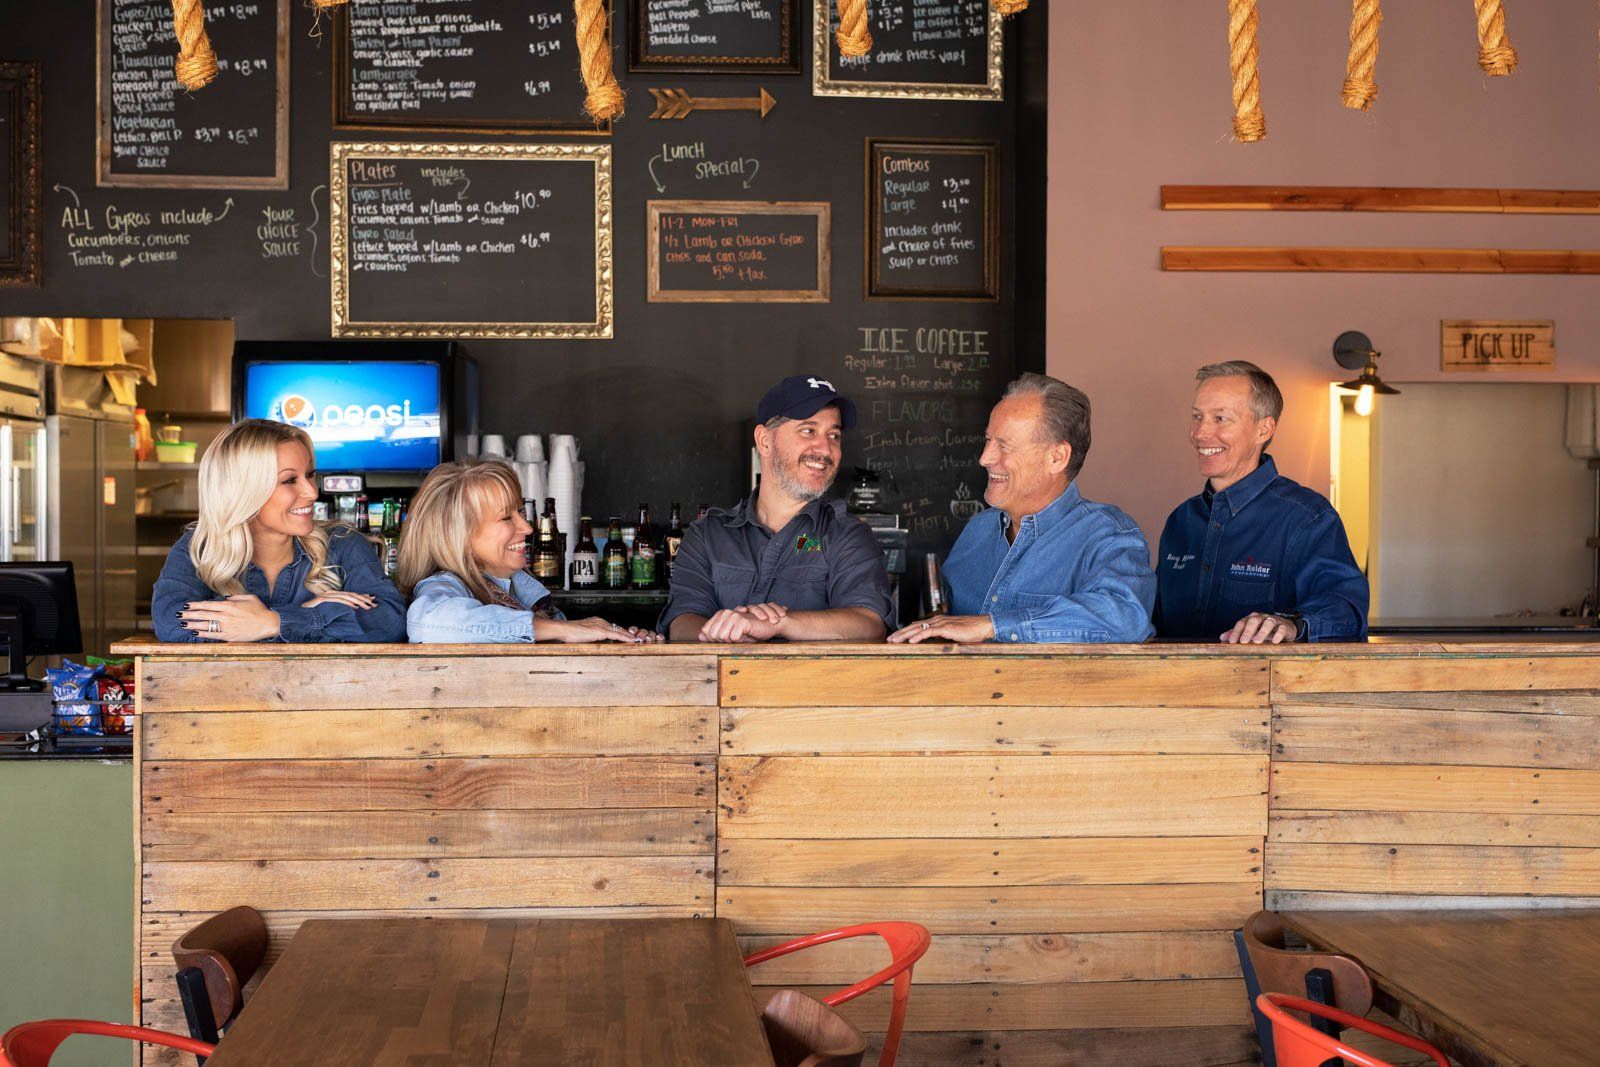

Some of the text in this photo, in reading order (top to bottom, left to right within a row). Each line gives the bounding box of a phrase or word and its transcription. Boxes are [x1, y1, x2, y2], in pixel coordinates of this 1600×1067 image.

[443, 24, 457, 34] on
[113, 54, 174, 71] Hawaiian
[882, 156, 930, 175] Combos
[883, 196, 917, 216] Large
[62, 206, 95, 231] ALL
[931, 220, 963, 236] drink
[933, 237, 947, 250] of
[71, 250, 115, 267] Tomato
[858, 326, 990, 355] ICE COFFEE
[1461, 332, 1536, 360] PICK UP
[321, 398, 411, 428] pepsi
[573, 559, 595, 576] IPA
